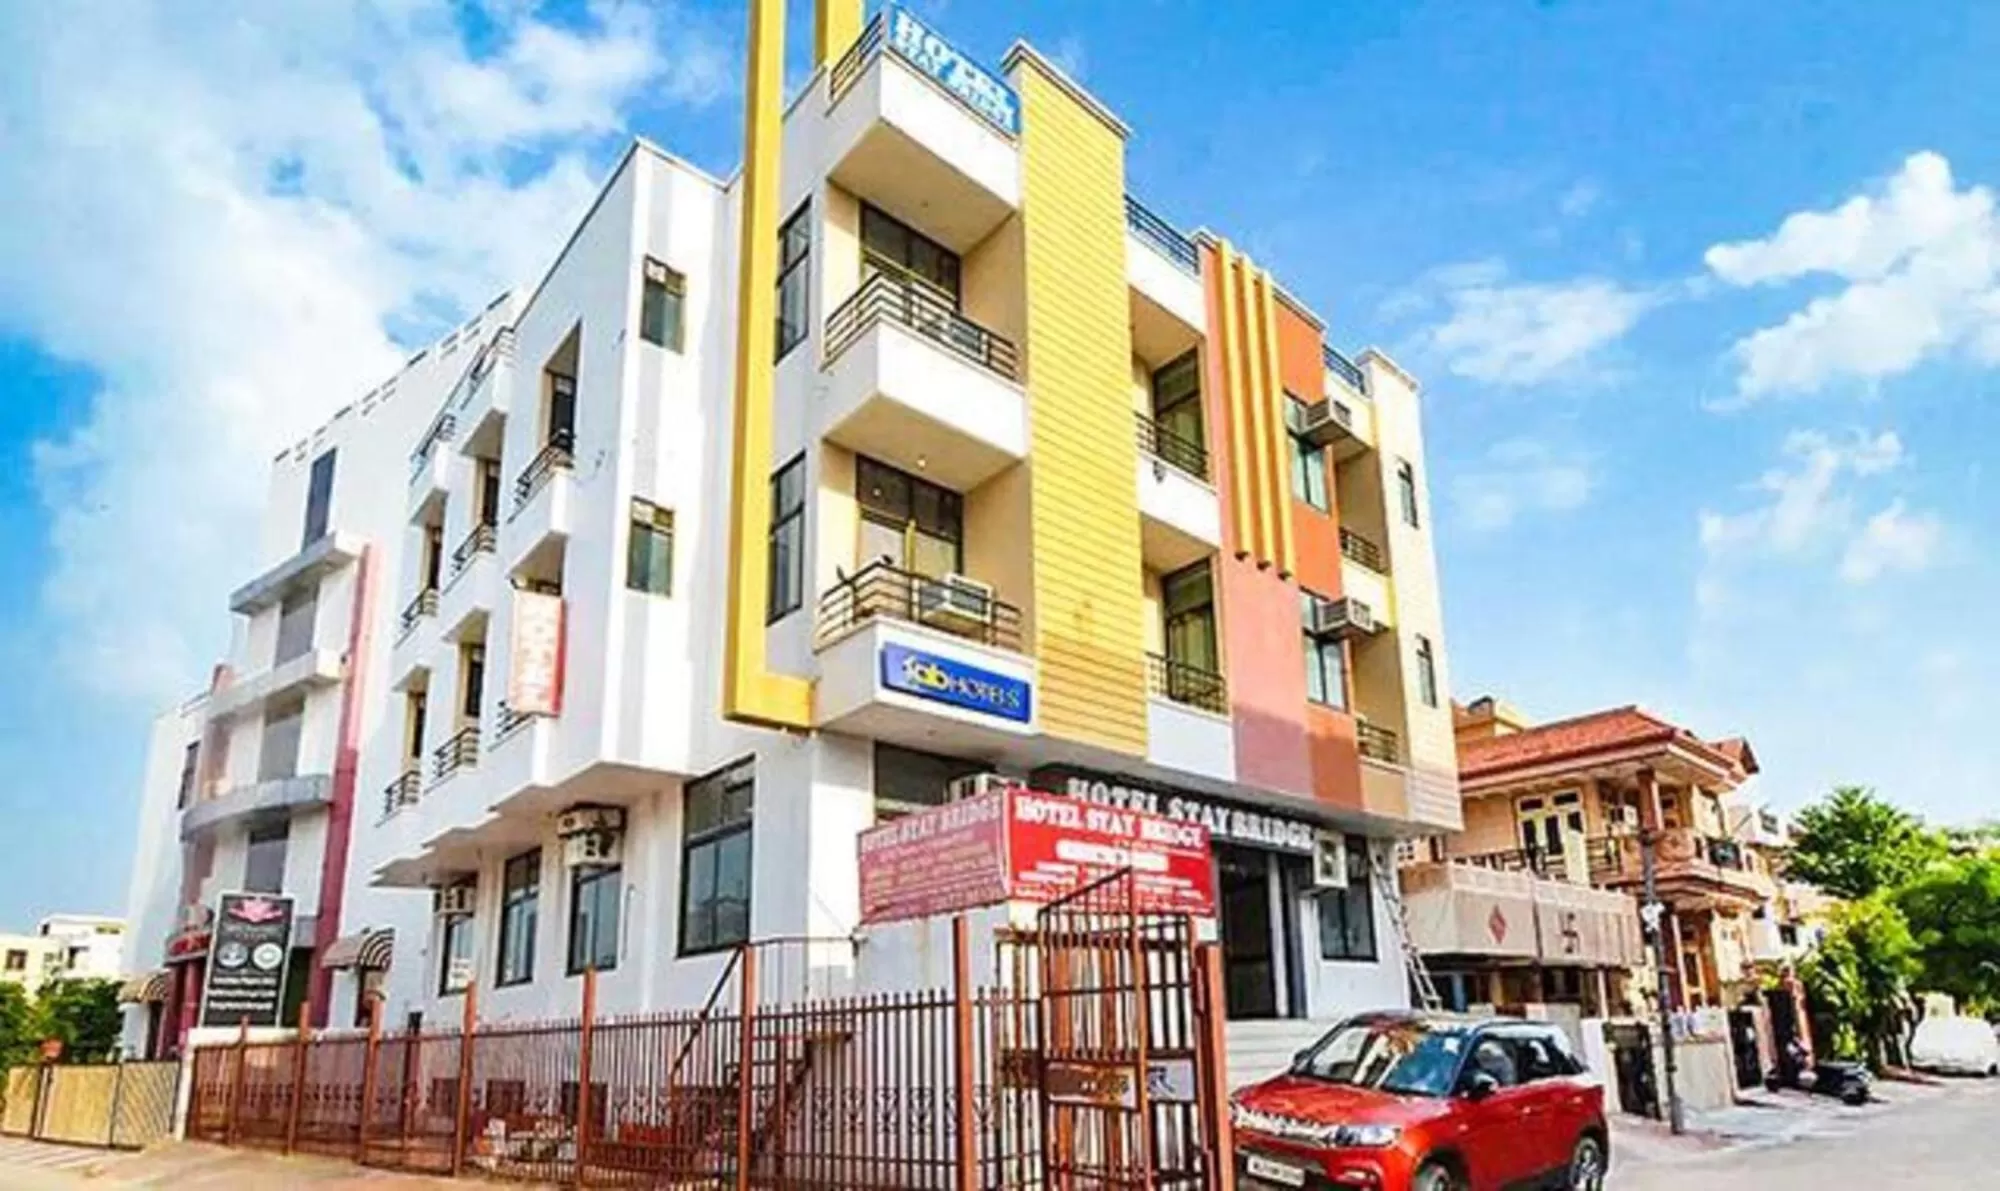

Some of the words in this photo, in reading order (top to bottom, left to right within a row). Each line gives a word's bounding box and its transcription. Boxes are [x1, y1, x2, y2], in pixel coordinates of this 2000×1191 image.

[1014, 795, 1082, 829] HOTEL
[1085, 808, 1136, 838] STAY
[1067, 777, 1159, 816] HOTEL
